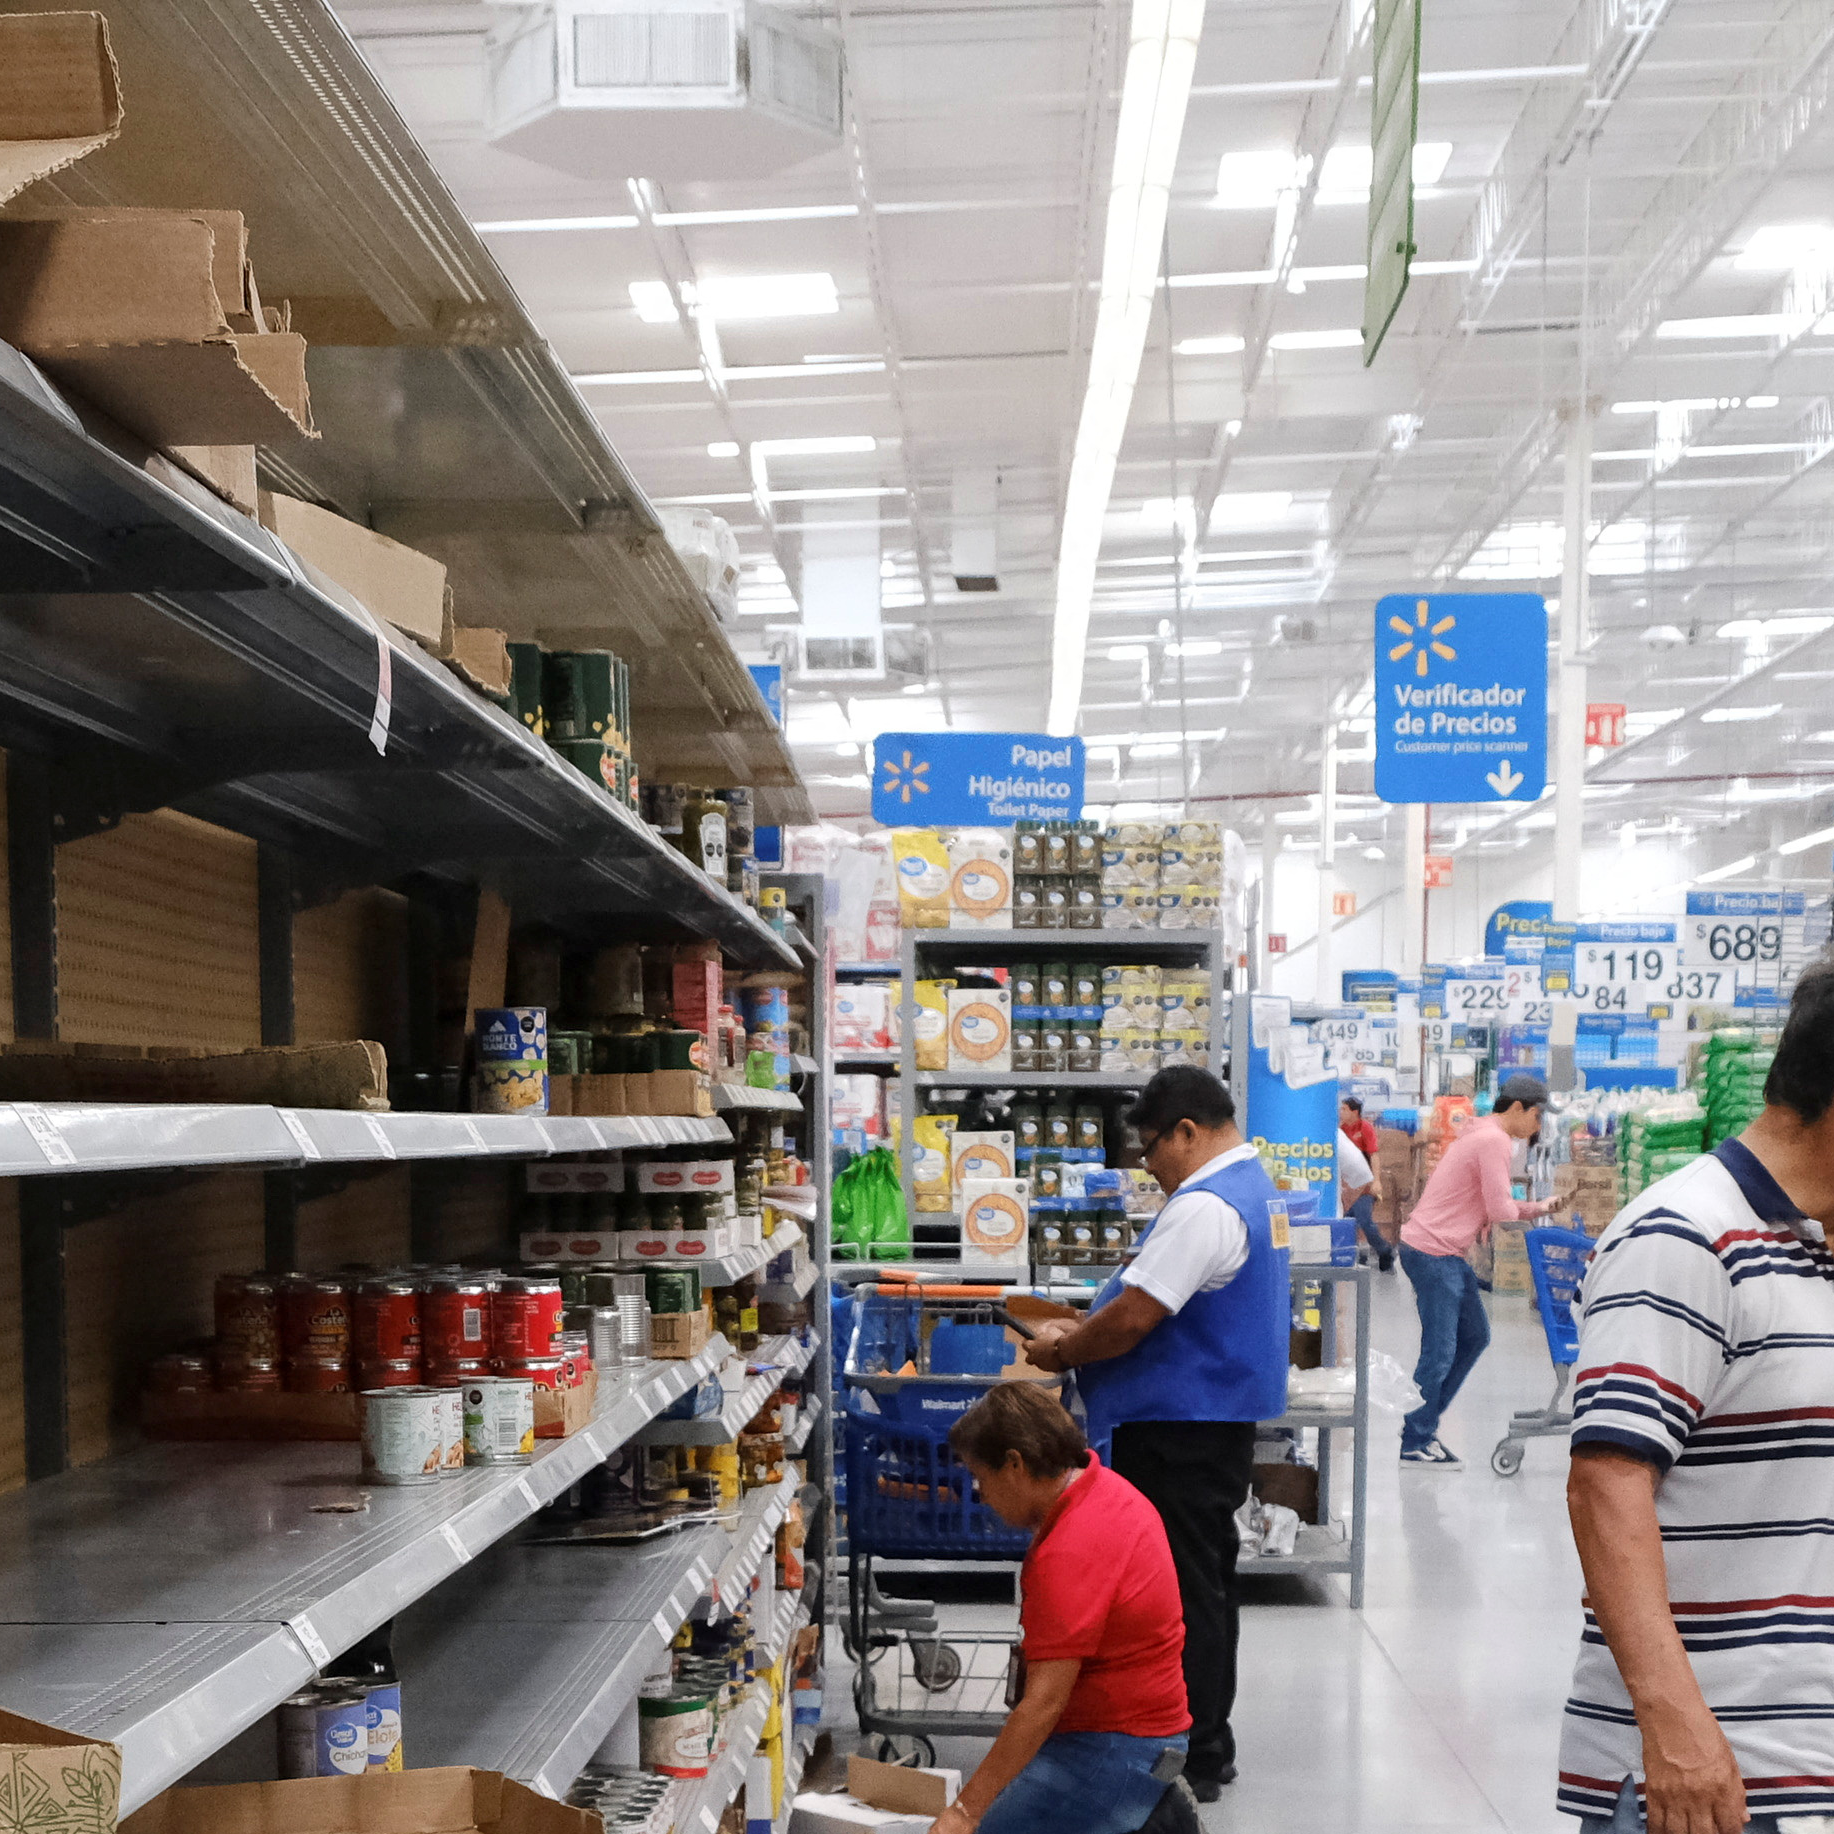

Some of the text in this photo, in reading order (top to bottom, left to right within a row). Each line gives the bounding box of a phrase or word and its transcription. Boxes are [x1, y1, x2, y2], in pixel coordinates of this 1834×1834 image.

[1394, 682, 1527, 707] Verificador
[1395, 711, 1517, 735] de Precios
[1011, 744, 1072, 771] Papel
[1454, 741, 1481, 754] price
[969, 775, 1071, 800] Higiénico
[988, 802, 1069, 819] Toilet Paper
[1715, 894, 1759, 909] Precio
[1496, 912, 1543, 931] Prec
[1600, 924, 1667, 940] Precio bajo
[1252, 1136, 1334, 1158] Precios
